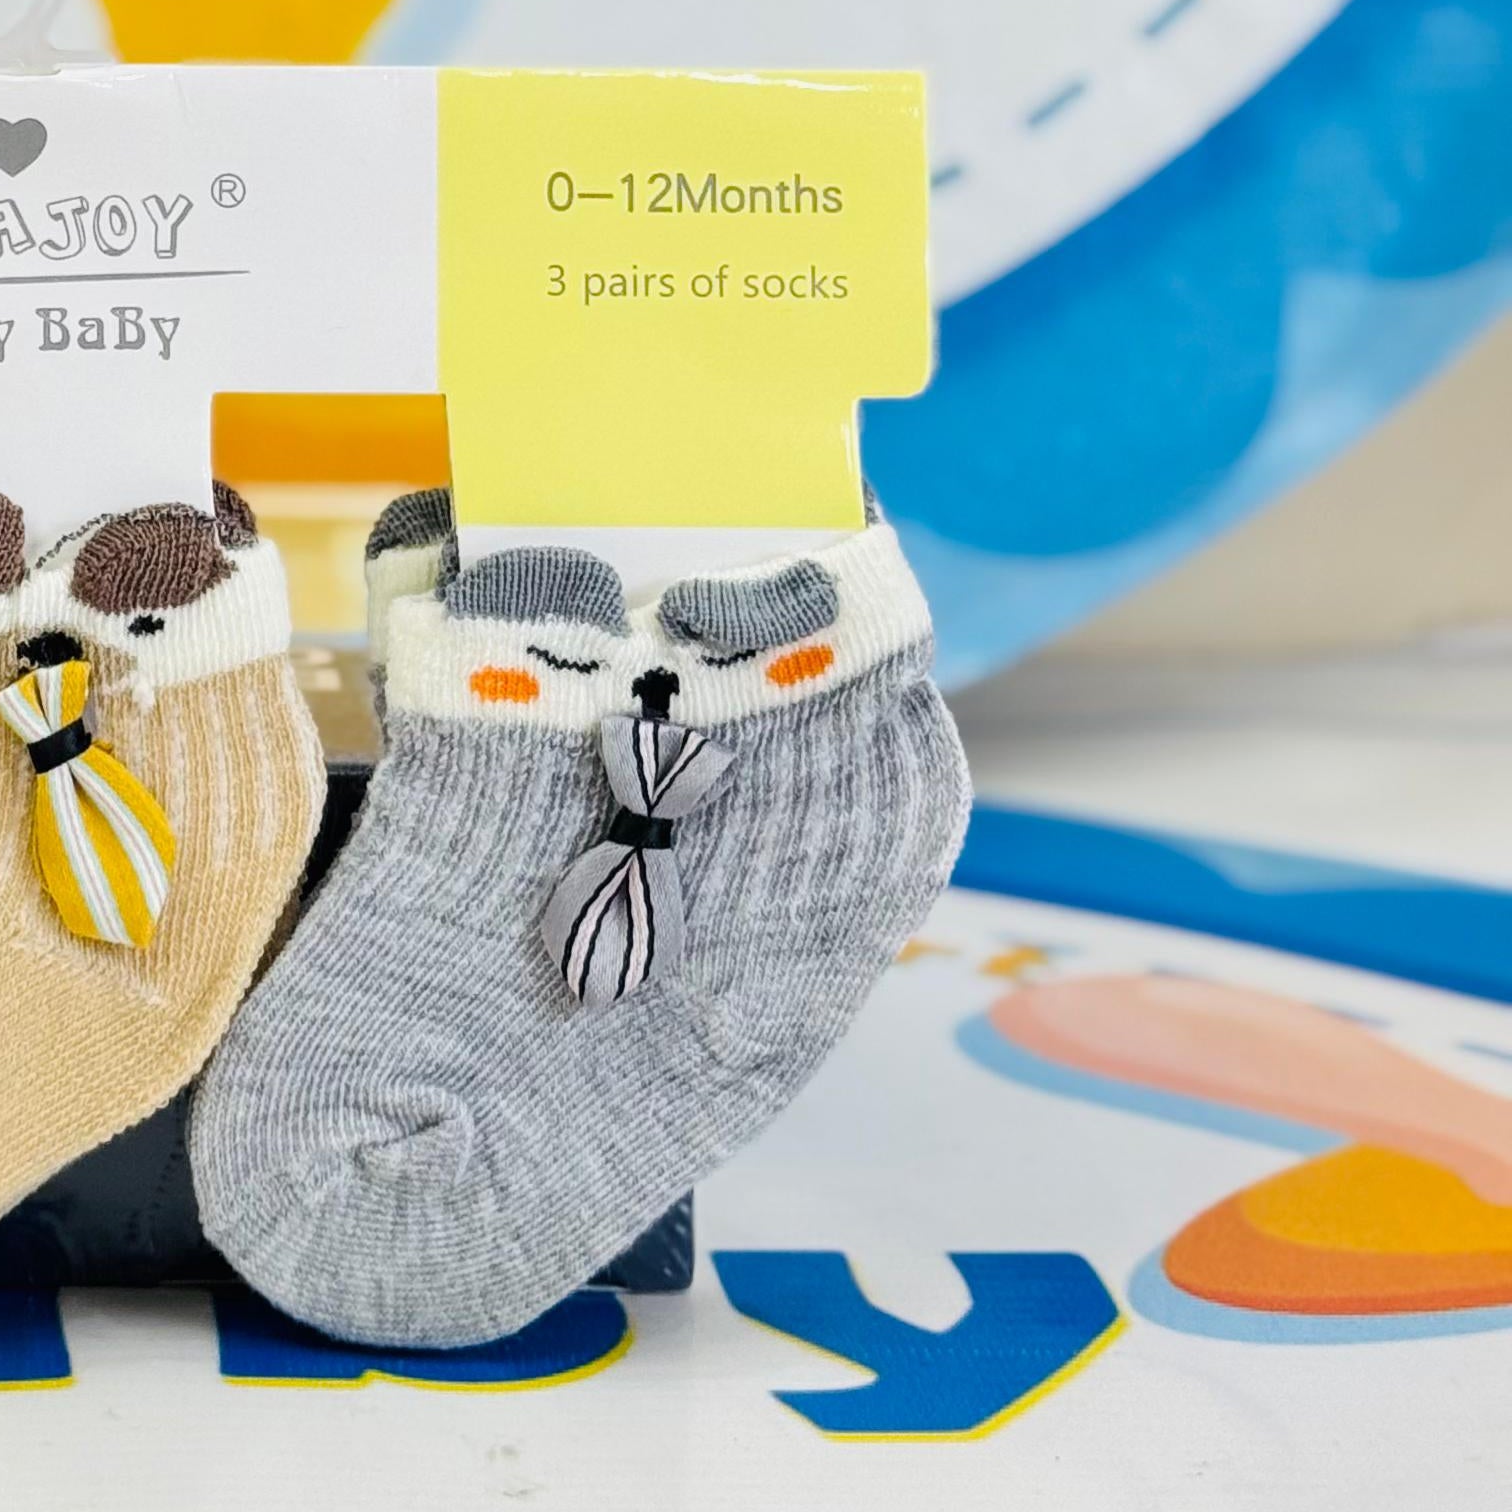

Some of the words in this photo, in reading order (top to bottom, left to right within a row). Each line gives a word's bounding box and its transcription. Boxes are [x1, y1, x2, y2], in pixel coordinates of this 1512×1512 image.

[546, 264, 566, 297] 3
[584, 264, 675, 306] pairs
[690, 263, 729, 298] of
[743, 264, 848, 299] socks
[35, 306, 181, 361] BaBy
